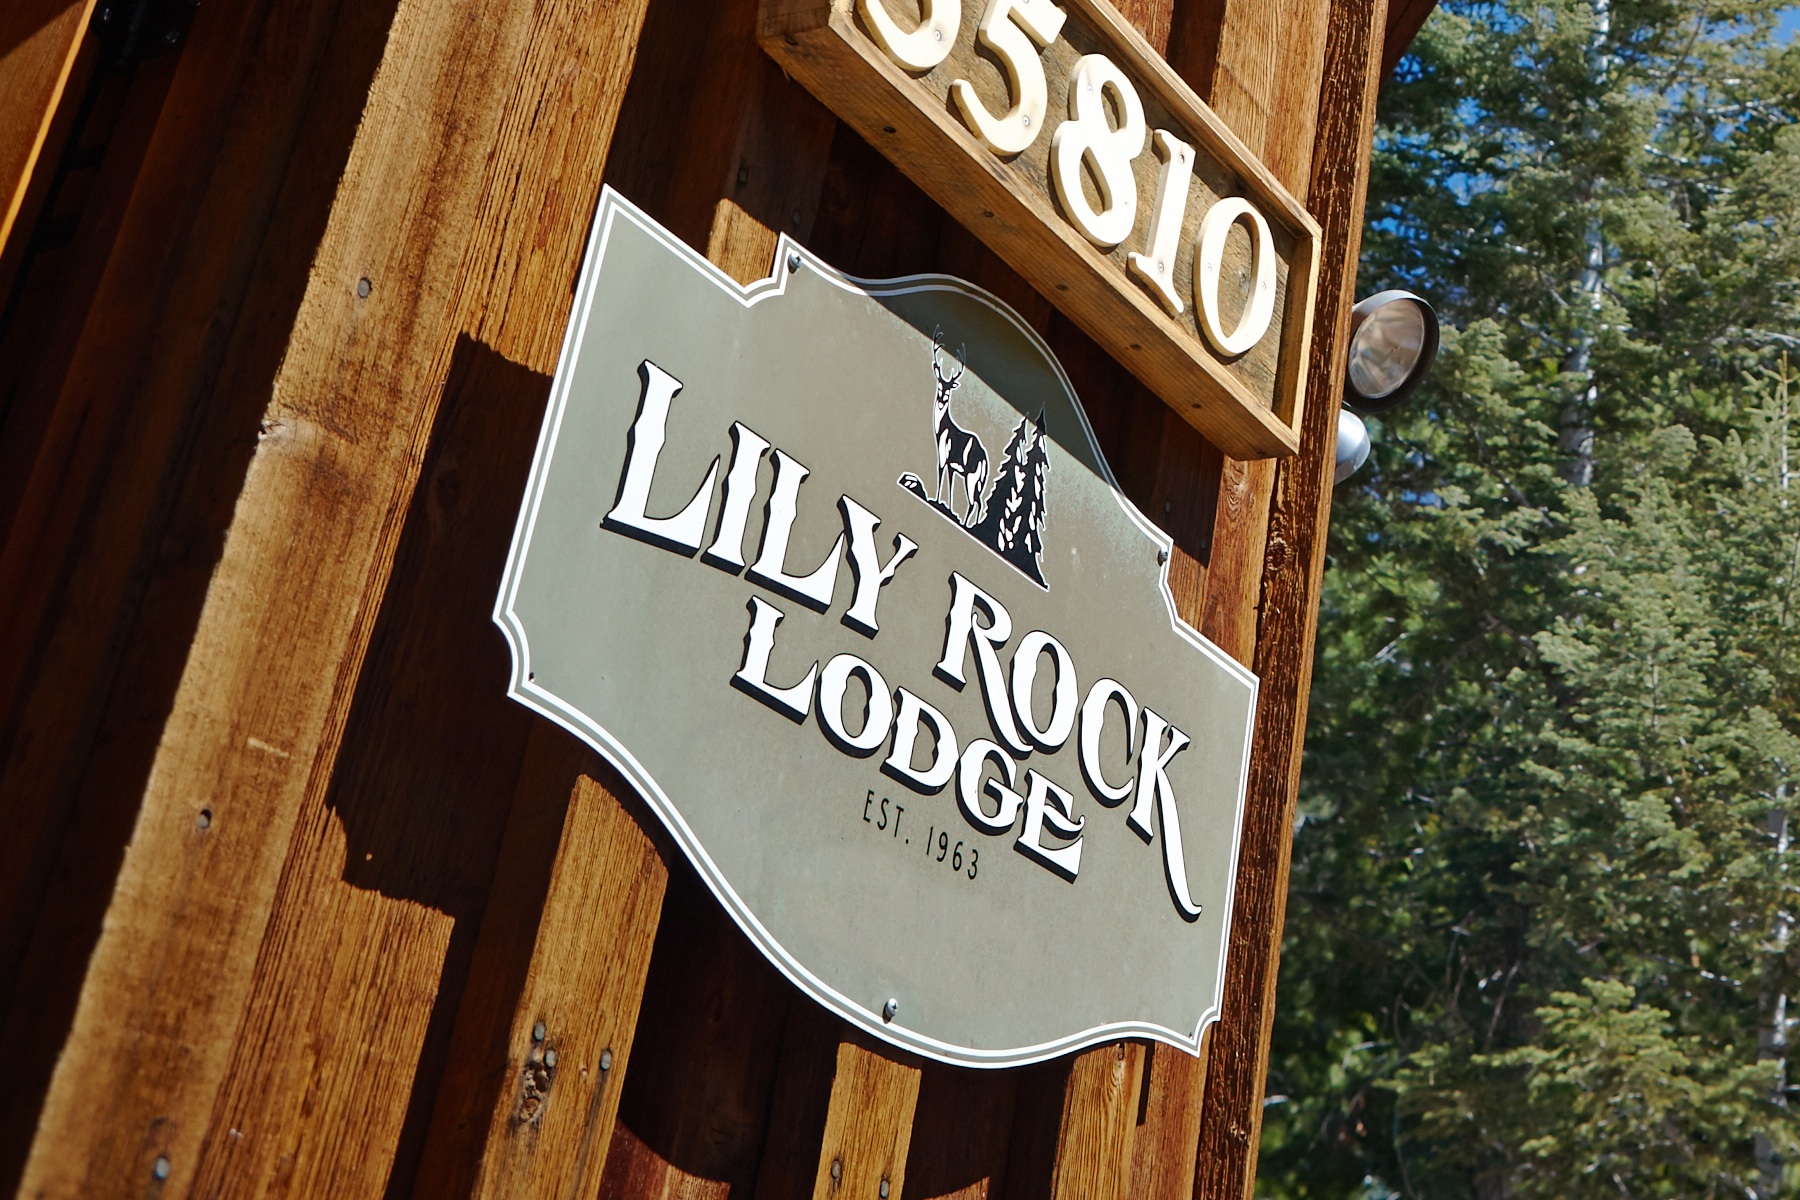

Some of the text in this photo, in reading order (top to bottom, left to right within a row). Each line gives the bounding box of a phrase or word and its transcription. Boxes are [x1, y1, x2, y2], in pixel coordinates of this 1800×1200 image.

[600, 358, 1202, 922] LILY ROCK
[730, 595, 1086, 882] LODGE
[862, 789, 980, 881] EST. 1963
